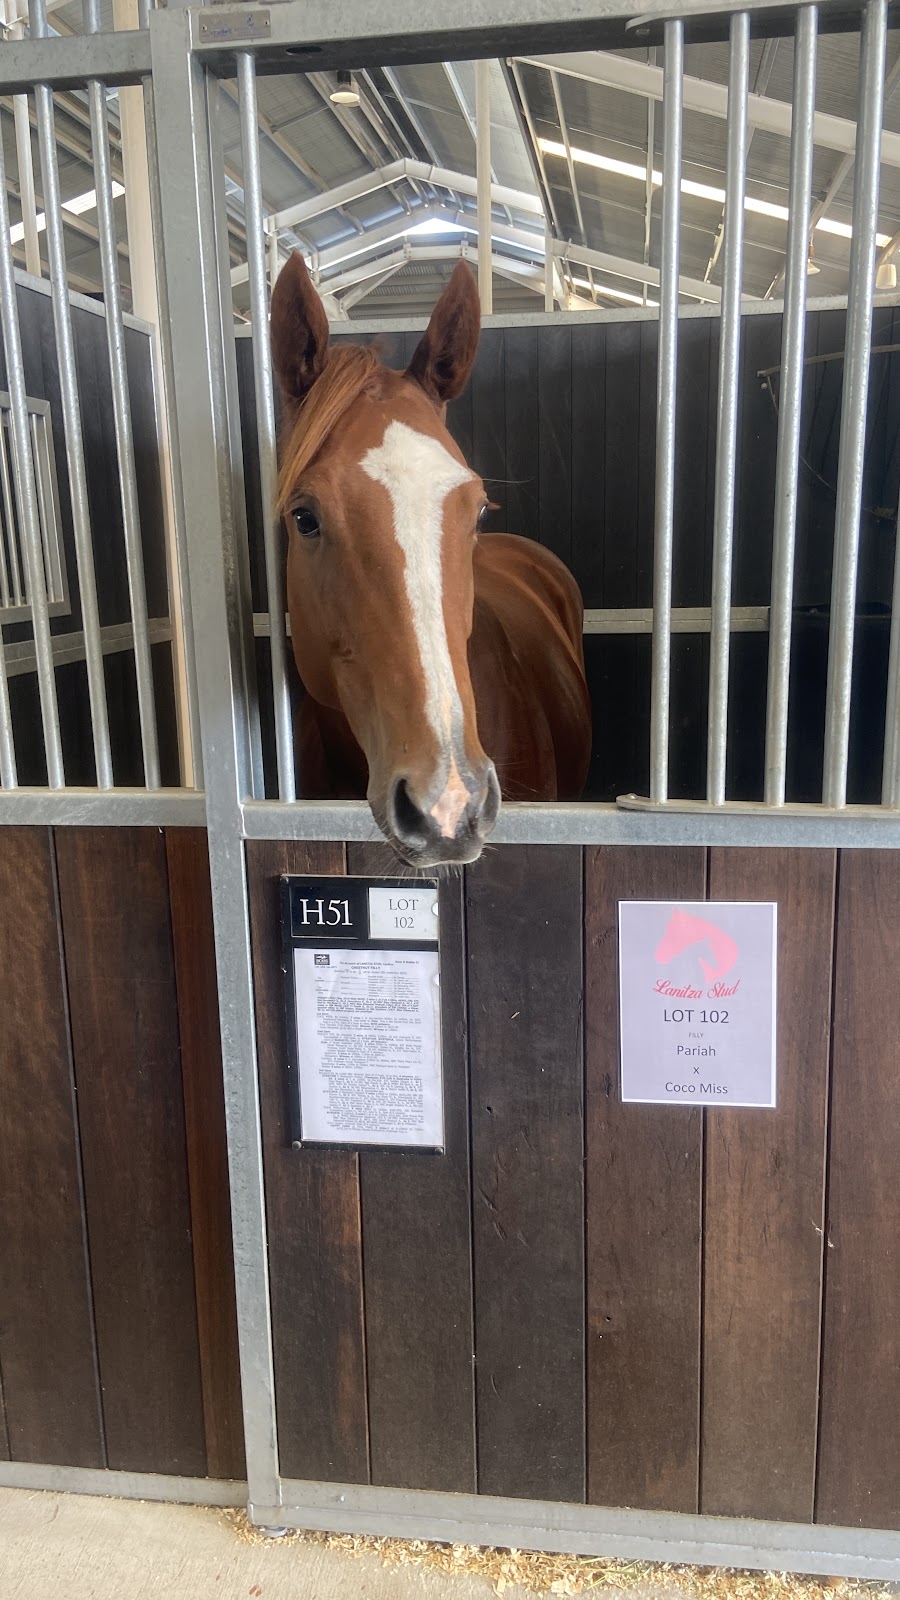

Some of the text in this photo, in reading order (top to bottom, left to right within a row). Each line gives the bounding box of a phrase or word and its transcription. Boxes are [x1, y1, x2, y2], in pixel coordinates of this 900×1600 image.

[388, 898, 419, 911] LOT
[300, 898, 353, 926] H51
[394, 916, 415, 929] 102
[652, 978, 741, 999] Lanitza Stud
[663, 1009, 729, 1024] LOT 102
[677, 1045, 716, 1057] Pariah
[665, 1082, 728, 1095] Coco Miss
